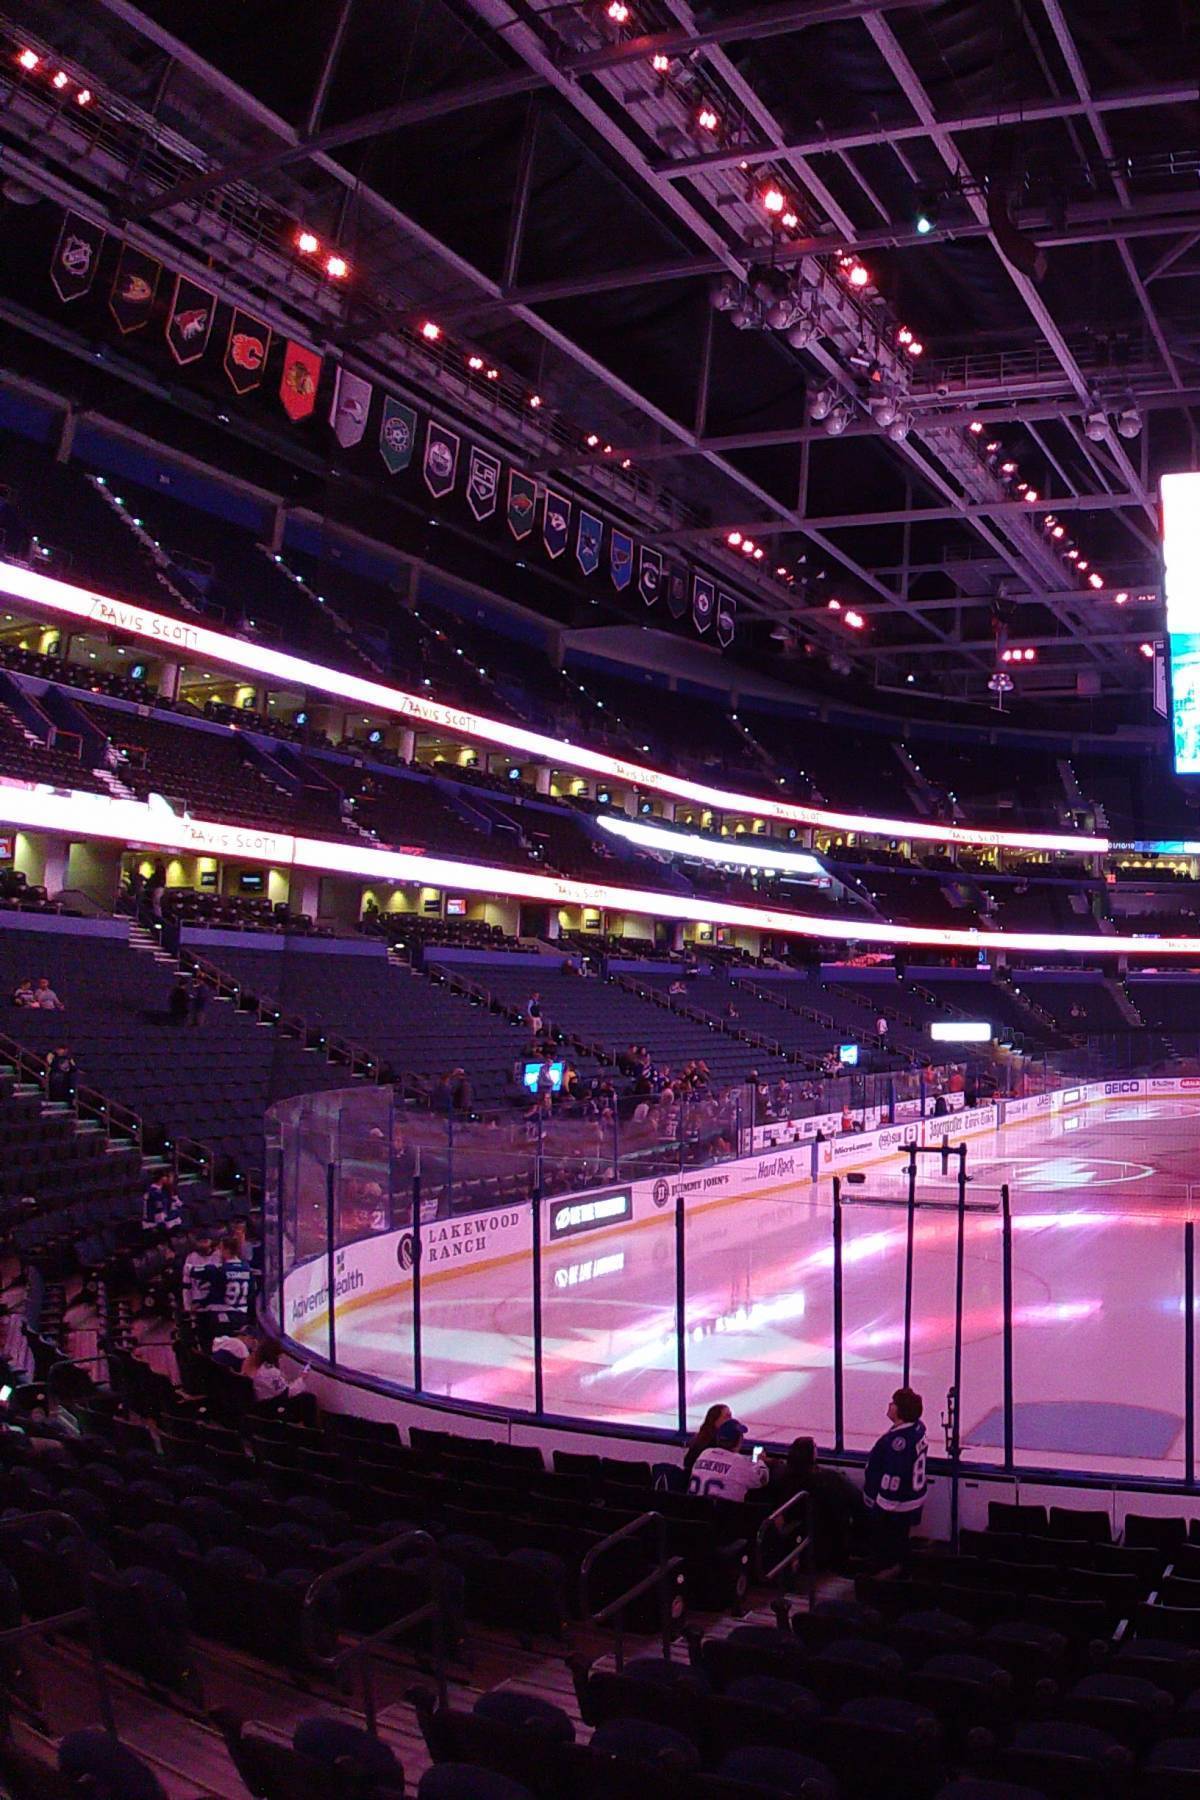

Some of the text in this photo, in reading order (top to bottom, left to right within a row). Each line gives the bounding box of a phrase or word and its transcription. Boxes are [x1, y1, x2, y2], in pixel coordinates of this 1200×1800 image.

[91, 598, 198, 648] TRAVIS SCOTT
[401, 697, 478, 733] TRAVIS SCOTT
[235, 834, 278, 856] SCOTT
[1104, 1081, 1140, 1095] GEICO
[758, 1156, 795, 1179] Hard Rock
[704, 1174, 729, 1192] JOHN'S
[429, 1213, 520, 1243] LAKEWOOD
[429, 1237, 486, 1262] RANCH
[292, 1268, 364, 1322] Adventealth
